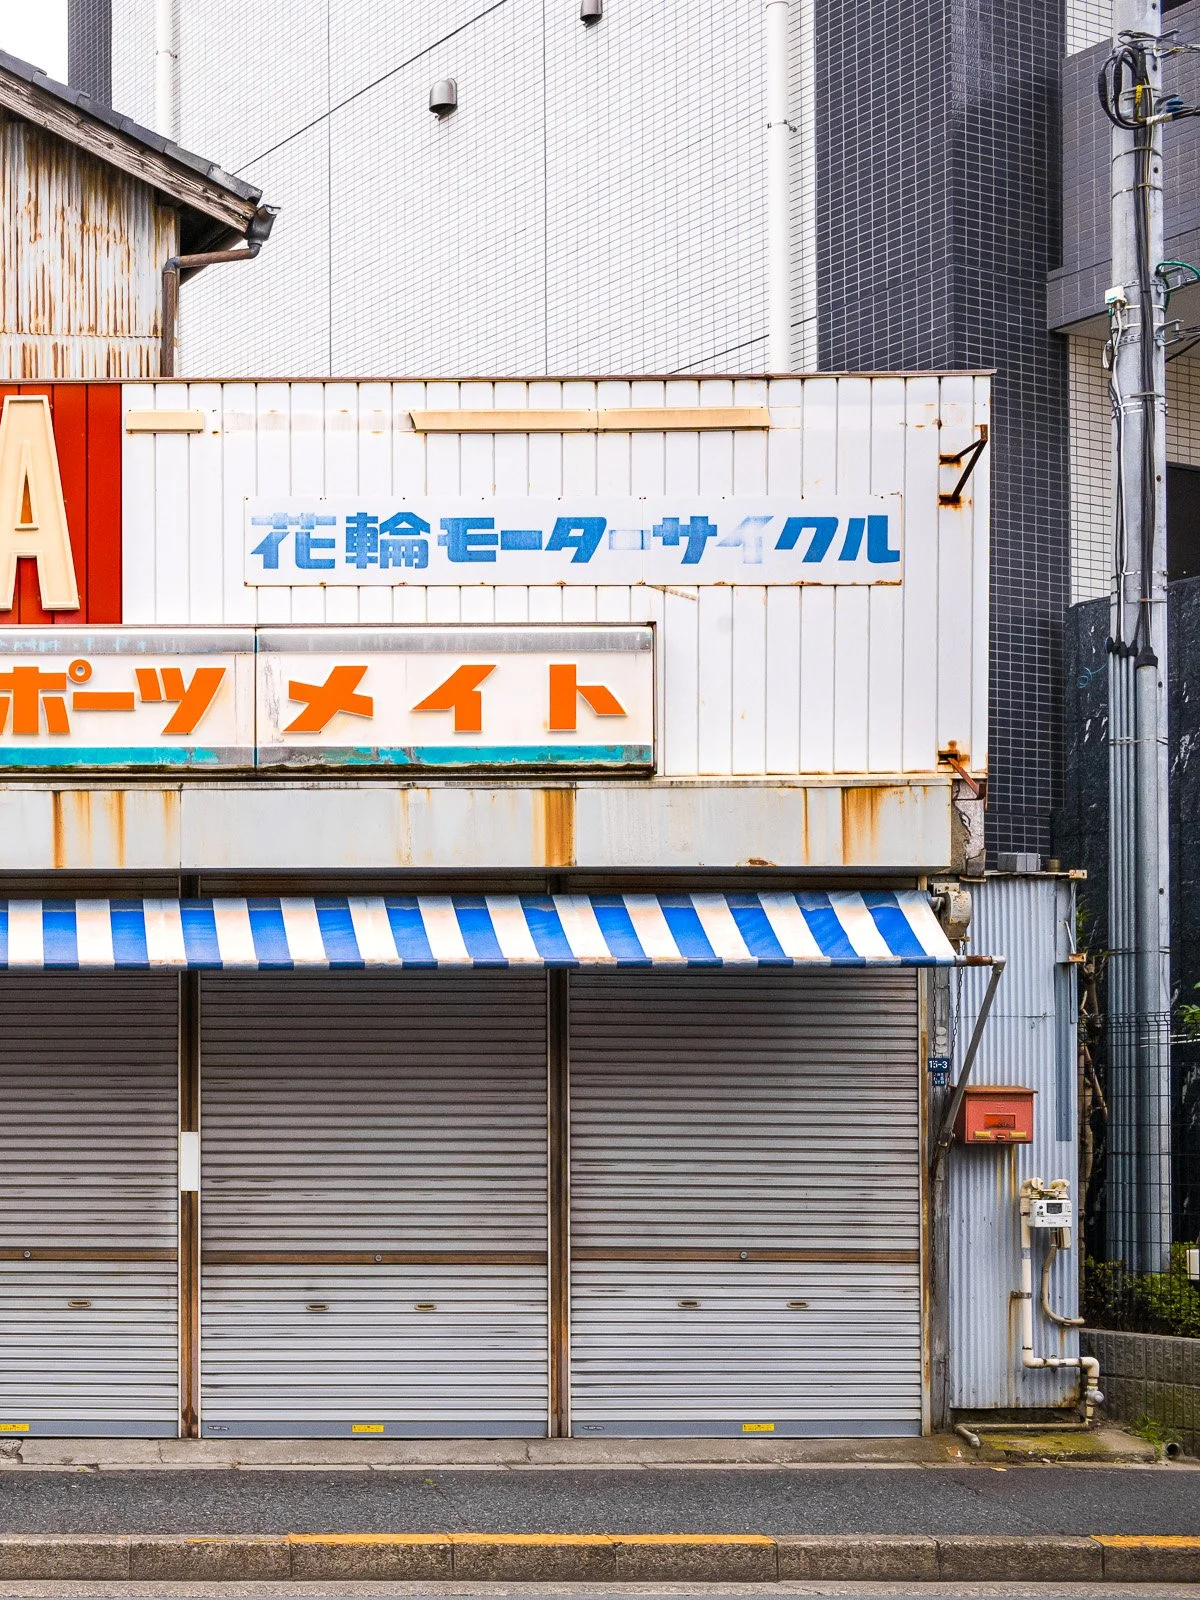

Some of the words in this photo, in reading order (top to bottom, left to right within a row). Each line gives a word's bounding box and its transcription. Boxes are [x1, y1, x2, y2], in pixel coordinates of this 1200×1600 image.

[251, 511, 900, 570] 花輪モーターサイクル
[284, 664, 627, 733] メイト
[929, 1060, 948, 1069] 15-3
